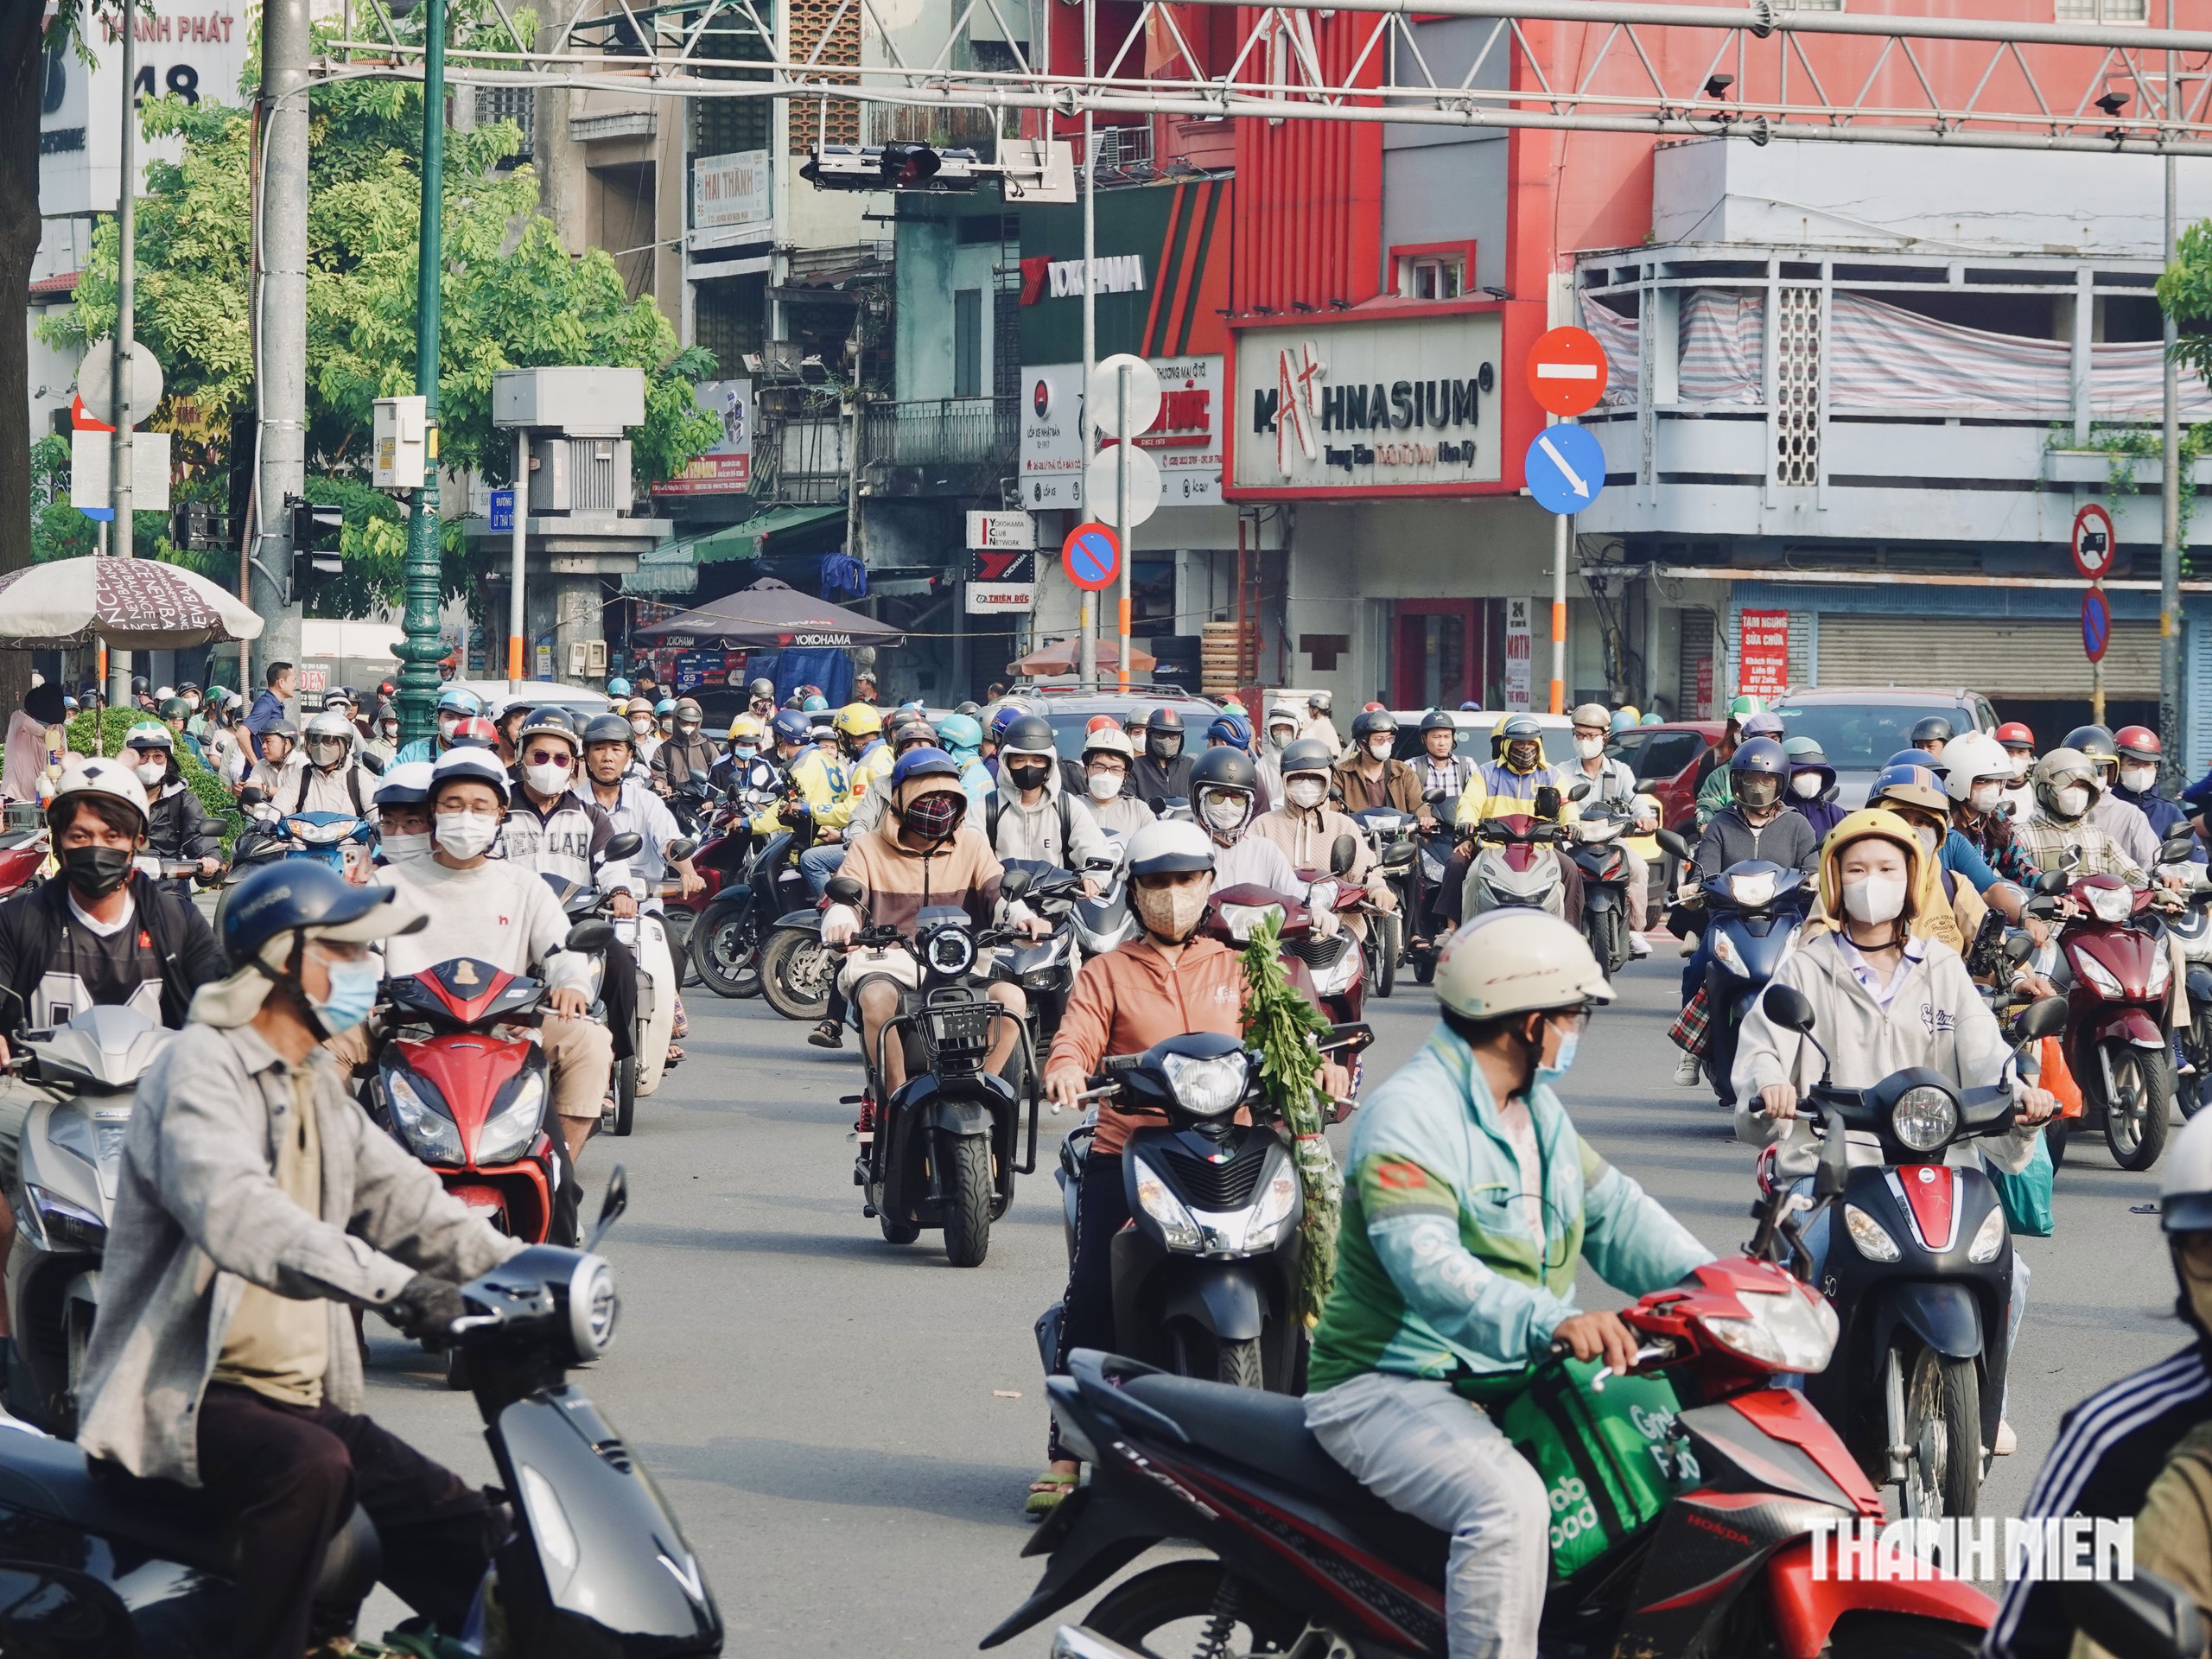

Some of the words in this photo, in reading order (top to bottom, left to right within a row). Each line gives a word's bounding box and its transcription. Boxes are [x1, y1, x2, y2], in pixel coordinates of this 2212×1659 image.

[177, 10, 234, 42] PHÁT
[989, 518, 1025, 528] YOKOHAMA
[989, 528, 1007, 537] CLUB
[989, 537, 1020, 546] NETWORK
[1002, 553, 1028, 579] YOKOHAMA
[666, 636, 695, 647] YOKOHAMA
[794, 633, 852, 646] YOKOHAMA
[1507, 634, 1529, 660] MATH
[548, 832, 588, 862] LAB
[1686, 1513, 1751, 1546] HONDA
